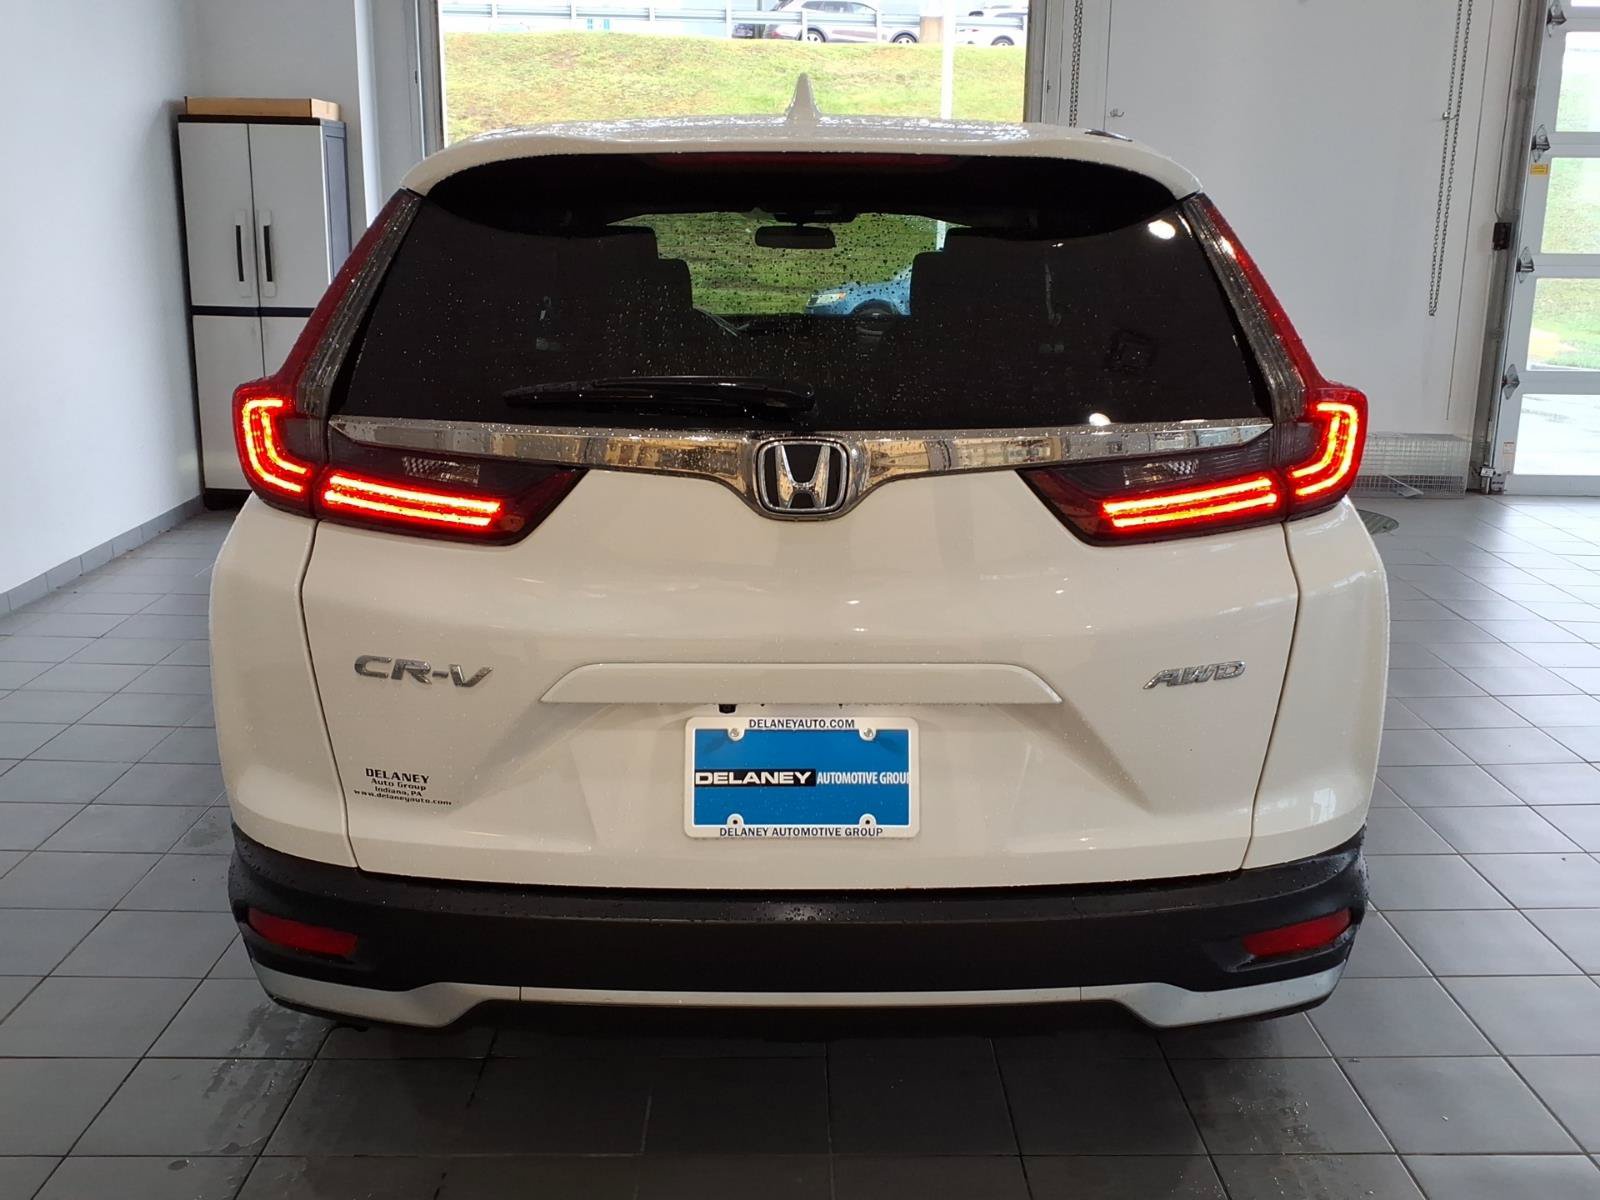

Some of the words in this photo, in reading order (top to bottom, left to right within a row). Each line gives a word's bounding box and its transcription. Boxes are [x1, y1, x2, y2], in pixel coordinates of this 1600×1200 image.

[354, 654, 493, 688] CR-V
[1143, 660, 1247, 690] AWD
[748, 718, 855, 729] DELANEYAUTO.COM
[365, 767, 430, 784] DELANEY
[695, 771, 812, 785] DELANEY
[816, 771, 878, 785] AUTOMOTIVE
[370, 778, 394, 787] Auto
[397, 781, 427, 791] Group
[374, 785, 410, 796] Indiana,
[353, 789, 452, 805] www.delaneyauto.com
[719, 827, 769, 837] DELANEY
[771, 827, 842, 837] AUTOMOTIVE
[844, 827, 884, 837] GROUP
